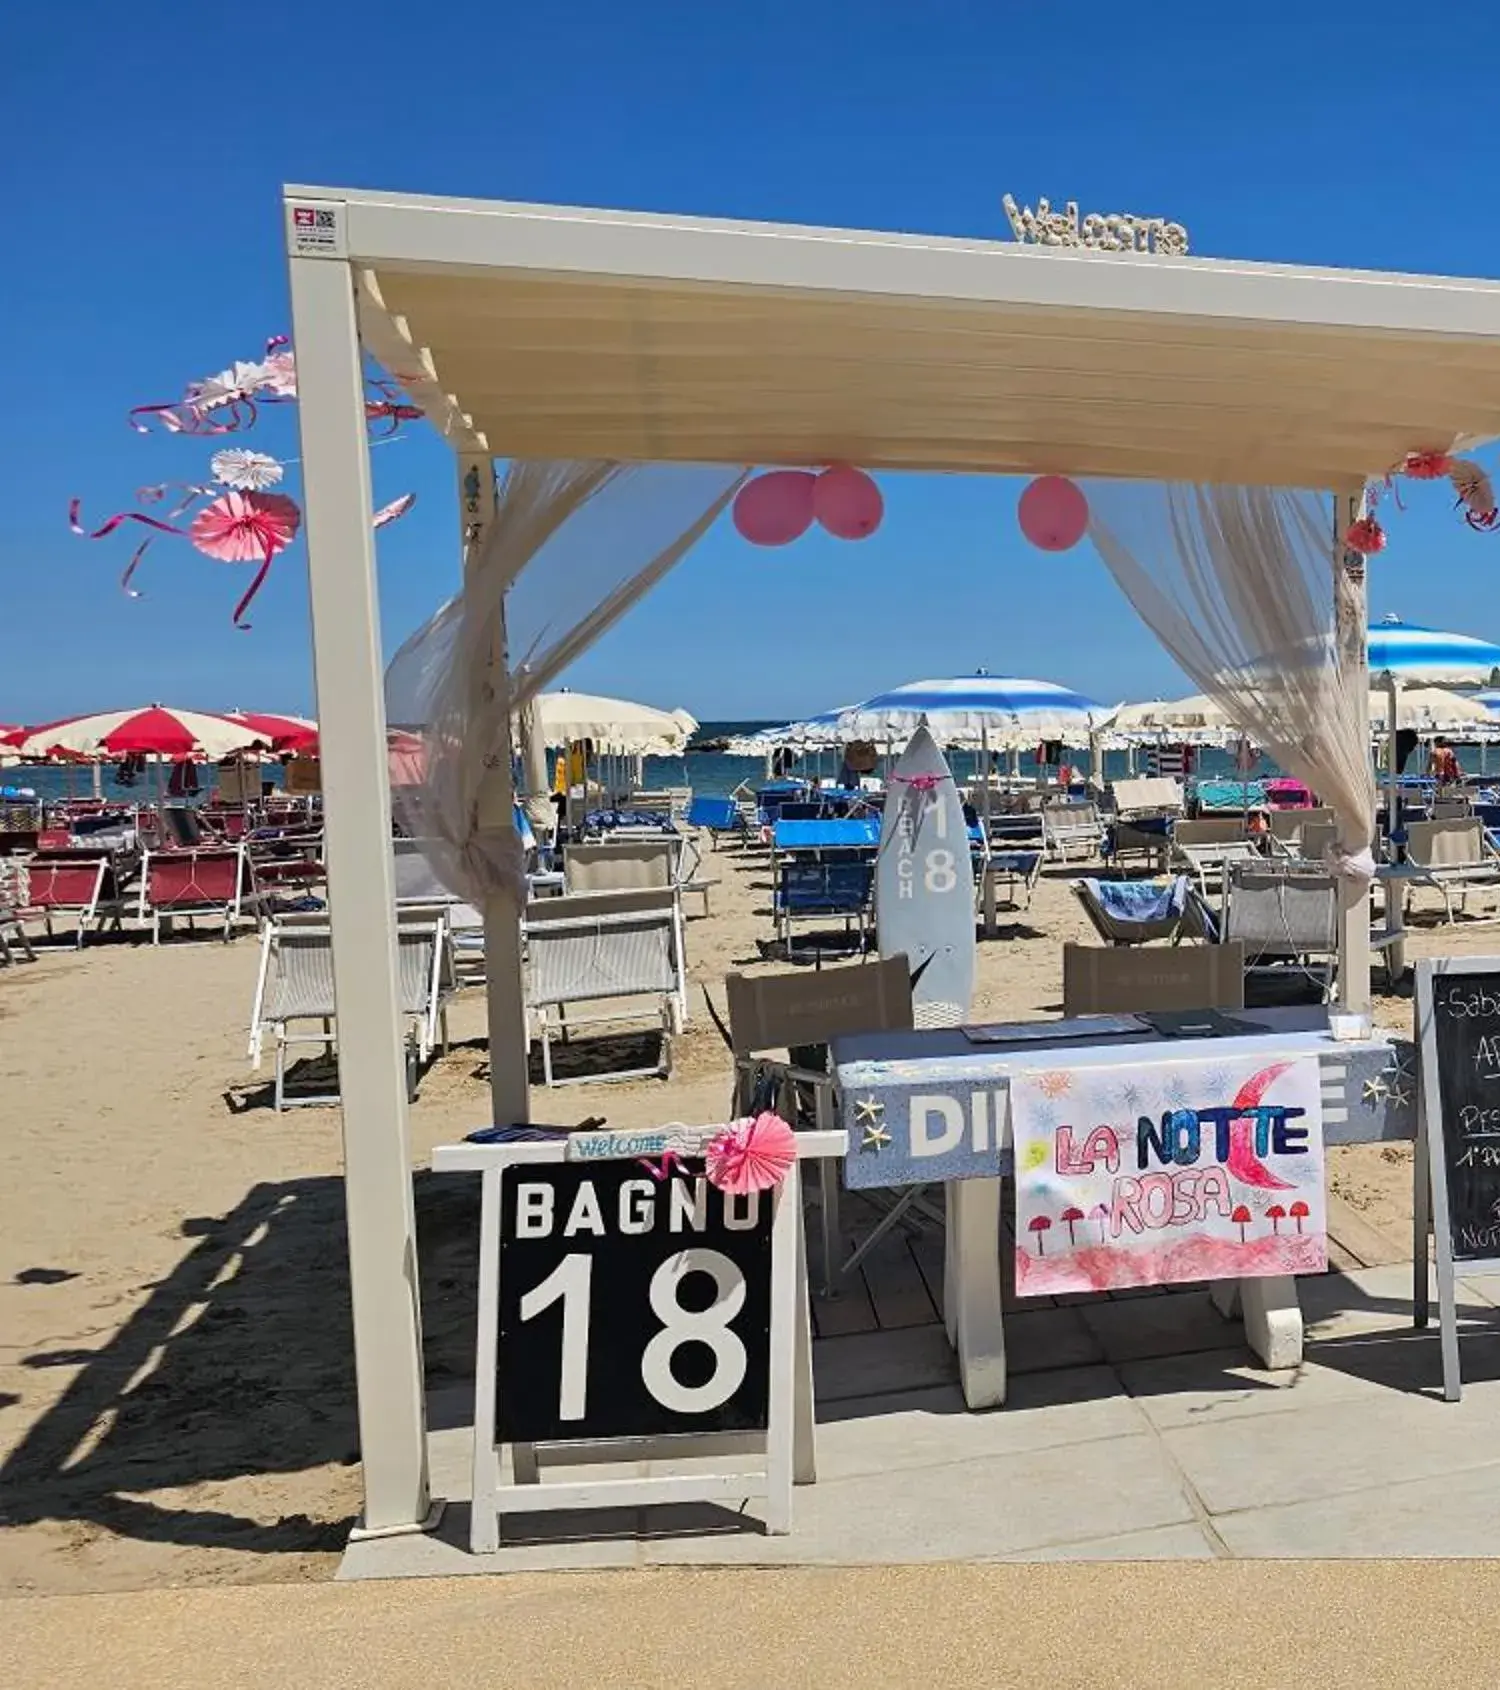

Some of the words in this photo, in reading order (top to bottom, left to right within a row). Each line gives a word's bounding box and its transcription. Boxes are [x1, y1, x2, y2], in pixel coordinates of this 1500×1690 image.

[924, 794, 957, 893] 18
[1055, 1124, 1121, 1174] LA
[1136, 1105, 1309, 1169] NOTTE
[515, 1178, 759, 1239] BAGNO
[1110, 1165, 1233, 1238] ROSA
[520, 1247, 748, 1421] 18
